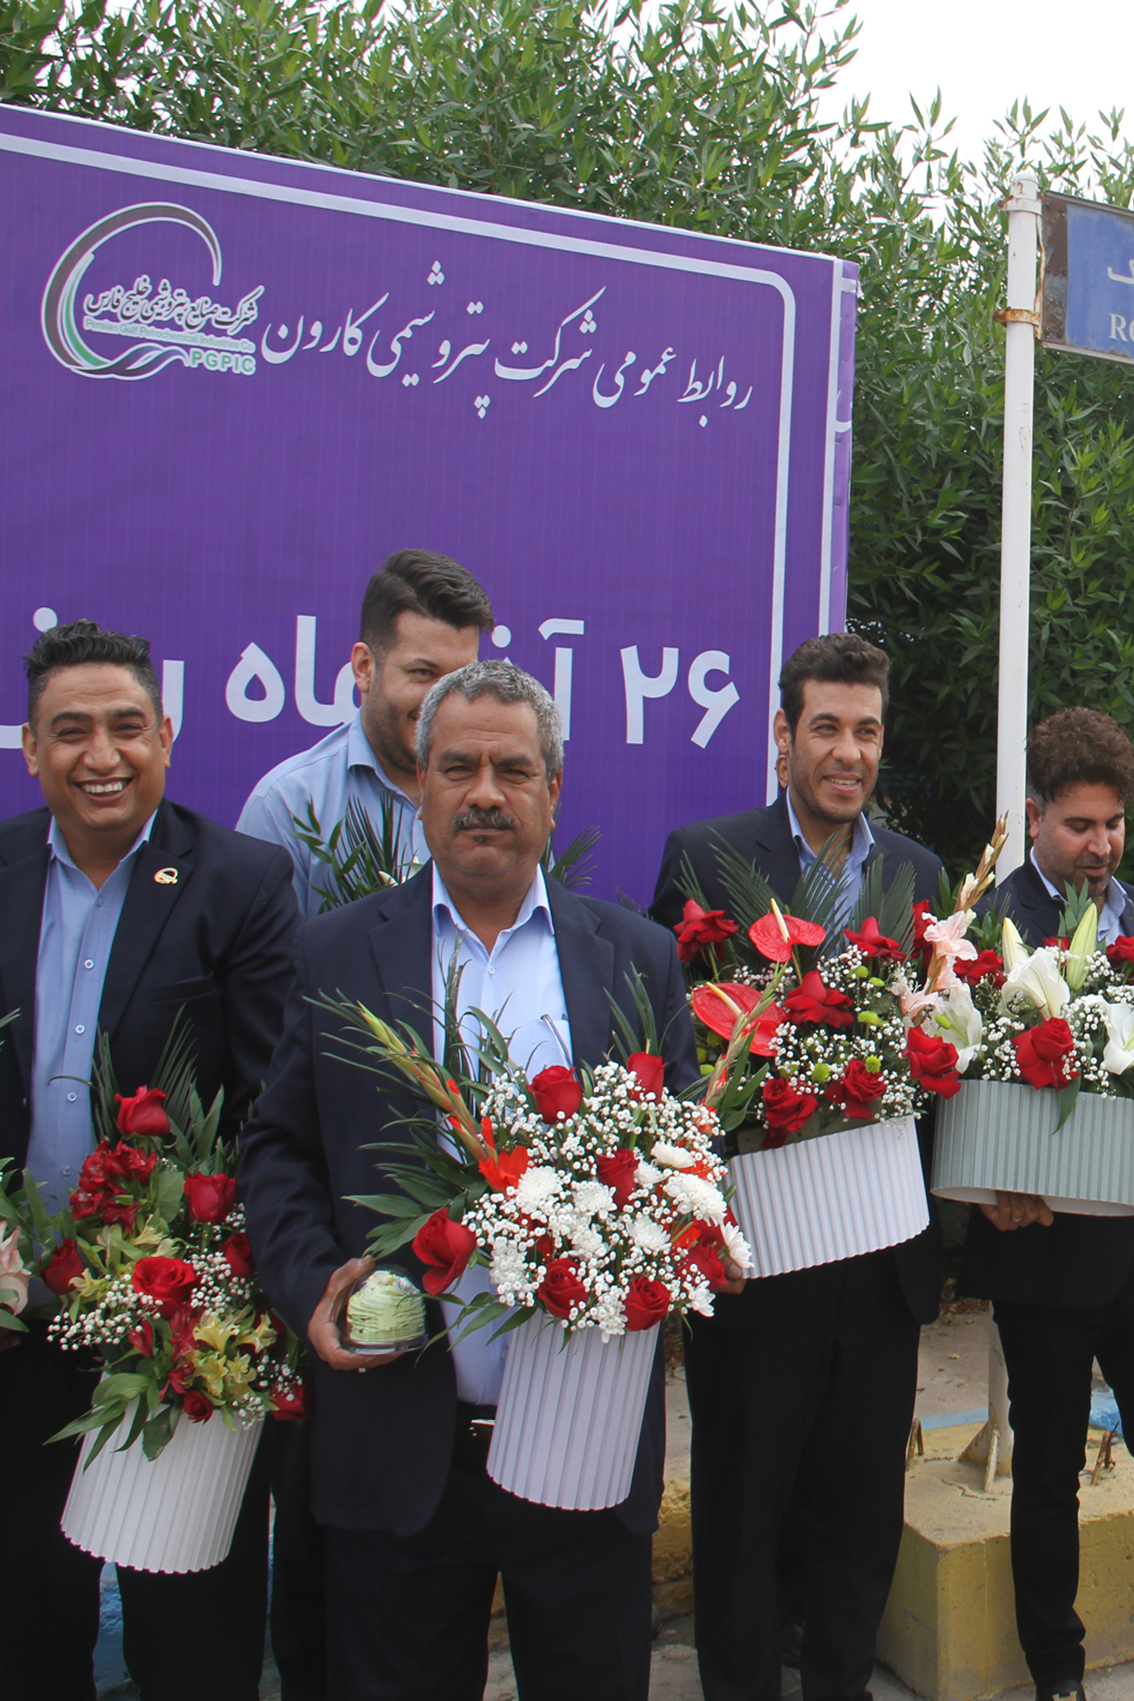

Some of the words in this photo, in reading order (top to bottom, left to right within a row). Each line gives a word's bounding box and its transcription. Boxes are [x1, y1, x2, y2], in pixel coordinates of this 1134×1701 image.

[85, 317, 118, 333] Persian
[213, 285, 264, 334] شرکت
[261, 292, 390, 365] کارون
[366, 260, 491, 419] پتروشیمی
[494, 285, 607, 398] شرکت
[190, 349, 256, 374] PGPIC
[592, 346, 677, 409] عمومی
[677, 354, 753, 428] روابط
[620, 645, 740, 749] ۲۶
